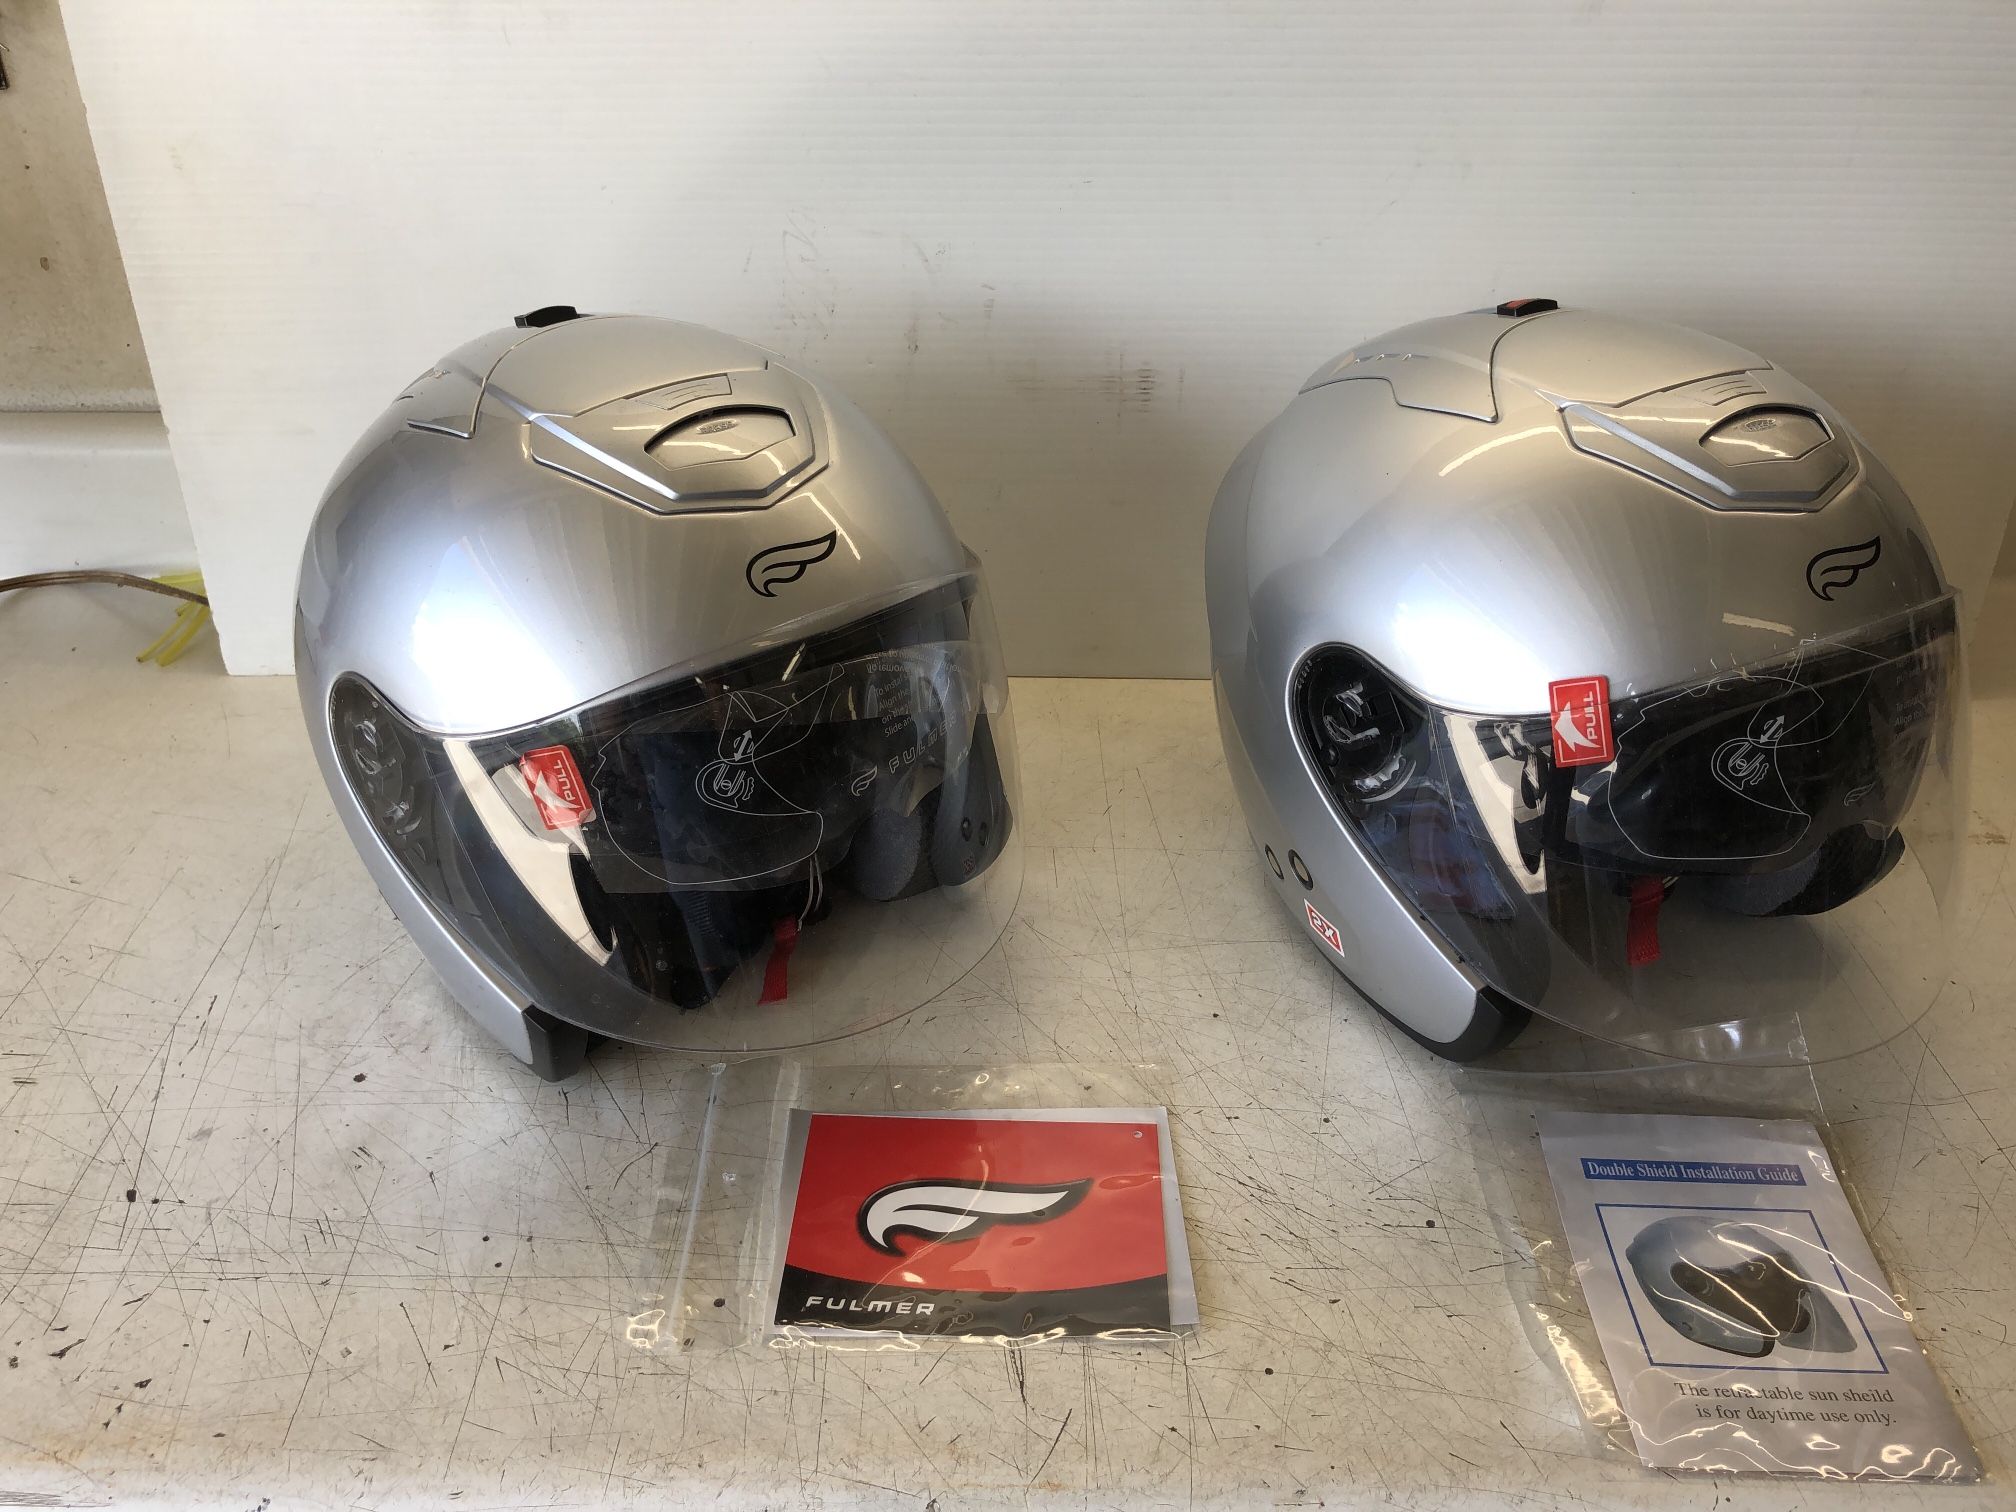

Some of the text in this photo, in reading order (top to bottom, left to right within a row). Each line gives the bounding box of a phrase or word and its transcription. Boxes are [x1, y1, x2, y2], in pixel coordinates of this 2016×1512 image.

[1583, 691, 1598, 740] PULL
[884, 722, 902, 738] Slide
[553, 759, 576, 801] PULL
[1311, 911, 1338, 946] 2X
[1587, 1161, 1799, 1182] Double Shield Installation Guide
[805, 1296, 935, 1316] FULMER
[1674, 1382, 1709, 1397] The
[1809, 1390, 1839, 1401] sun
[1843, 1388, 1894, 1403] sheild
[1695, 1404, 1897, 1427] is for daytime use only.
